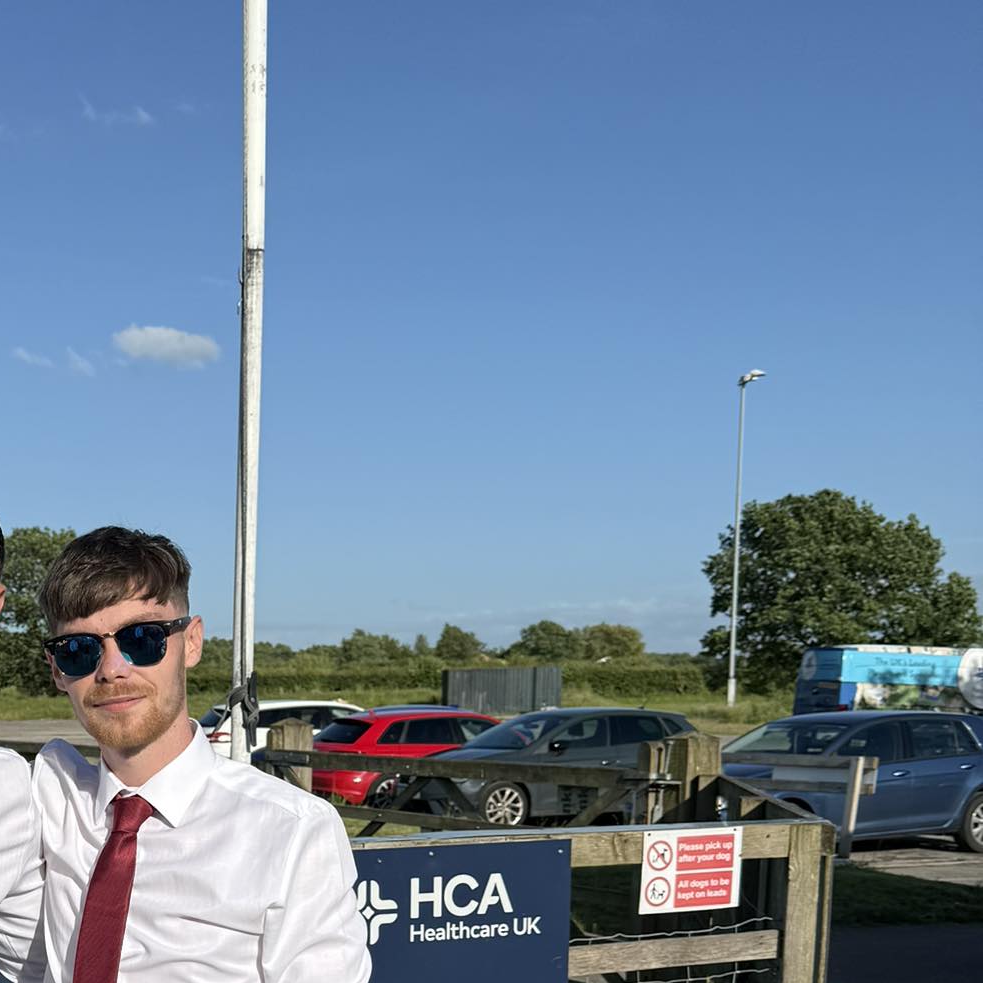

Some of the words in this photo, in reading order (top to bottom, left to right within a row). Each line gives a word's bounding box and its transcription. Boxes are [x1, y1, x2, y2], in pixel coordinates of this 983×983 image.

[679, 842, 704, 851] Please
[705, 841, 722, 852] pick
[722, 842, 733, 851] up
[678, 854, 697, 863] after
[697, 854, 715, 863] your
[715, 852, 731, 861] dog
[678, 880, 689, 888] All
[690, 879, 709, 889] dogs
[720, 878, 729, 886] be
[410, 873, 514, 919] HCA
[677, 890, 695, 900] kept
[696, 890, 706, 898] on
[707, 888, 727, 897] leads
[410, 921, 509, 943] Healthcare
[513, 916, 541, 935] UK
